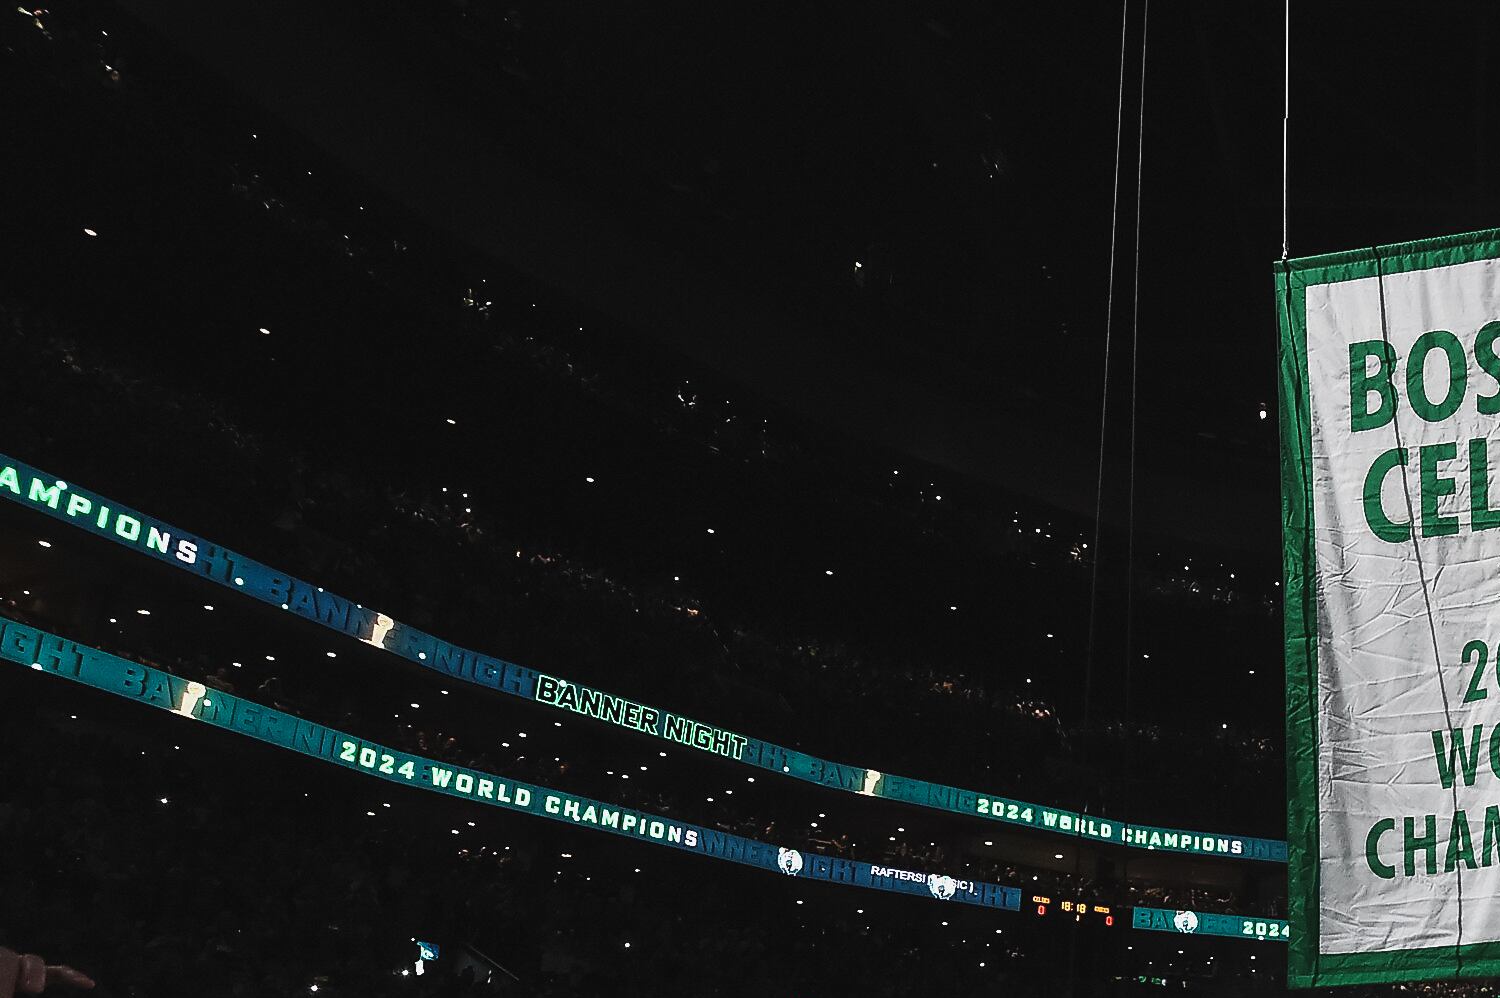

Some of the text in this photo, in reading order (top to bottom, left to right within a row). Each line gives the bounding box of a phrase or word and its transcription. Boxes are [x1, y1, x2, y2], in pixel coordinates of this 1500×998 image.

[536, 675, 660, 736] BANNER
[664, 714, 748, 761] NIGHT
[340, 741, 699, 848] 2024 WORLD CHAMPIONS
[977, 798, 1033, 822] 2024
[1043, 811, 1112, 838] WORLD
[1122, 828, 1243, 855] CHAMPIONS
[1038, 905, 1044, 915] 0
[1062, 901, 1086, 914] 18:18
[1106, 916, 1113, 926] 0
[1242, 920, 1290, 938] 2024
